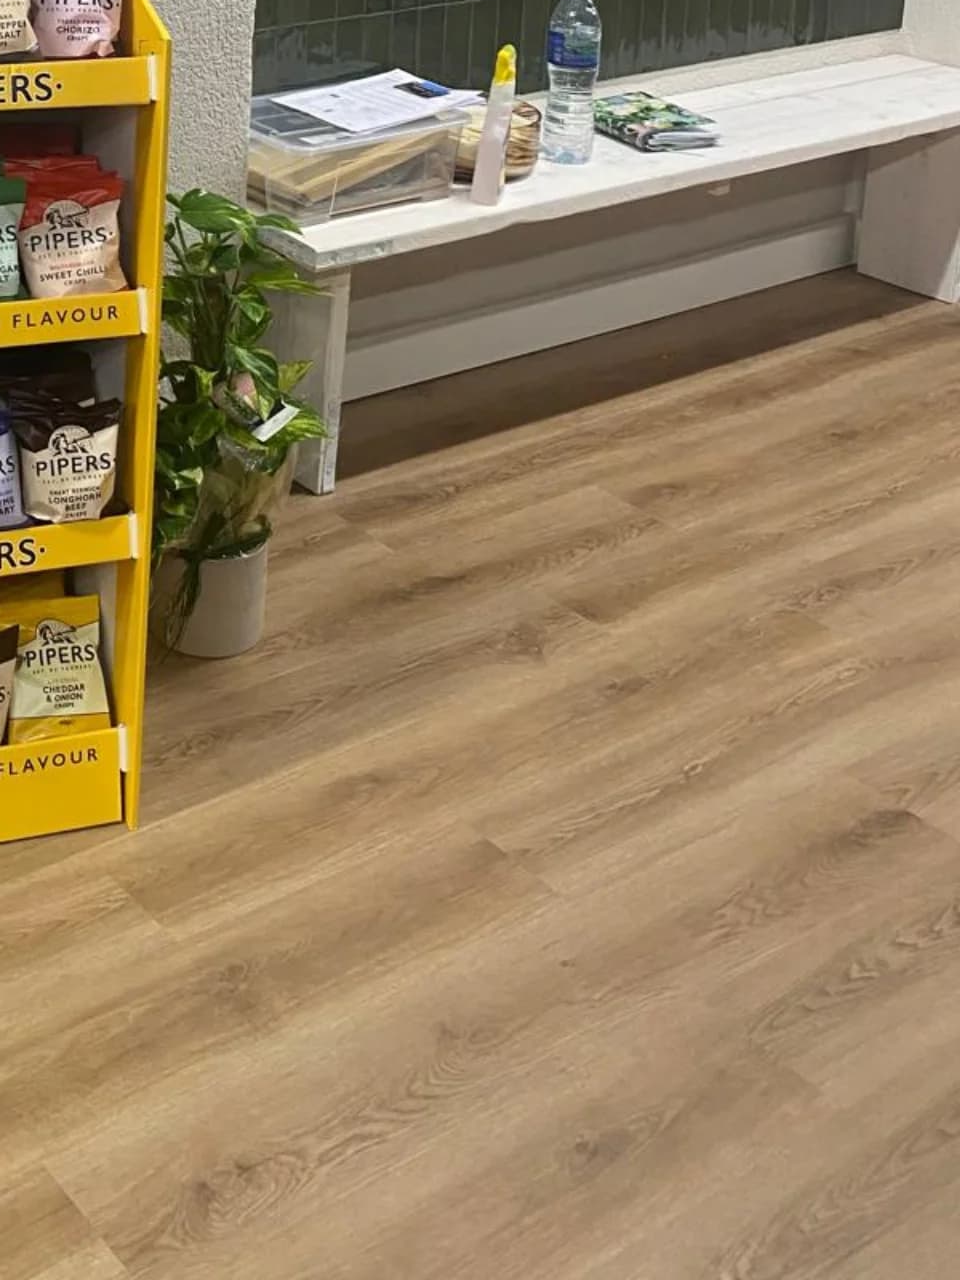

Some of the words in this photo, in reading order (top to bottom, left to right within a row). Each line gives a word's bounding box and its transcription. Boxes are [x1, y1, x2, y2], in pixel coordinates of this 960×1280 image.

[56, 26, 100, 34] CHORIZO
[30, 226, 107, 252] PIPERS
[40, 270, 72, 282] SWEET
[12, 305, 119, 329] FLAVOUR
[36, 452, 111, 477] PIPERS
[48, 492, 102, 504] LONGHORN
[65, 503, 86, 512] BEEF
[25, 644, 95, 668] PIPERS
[42, 684, 85, 694] CHEDDAR
[54, 693, 83, 702] ONION
